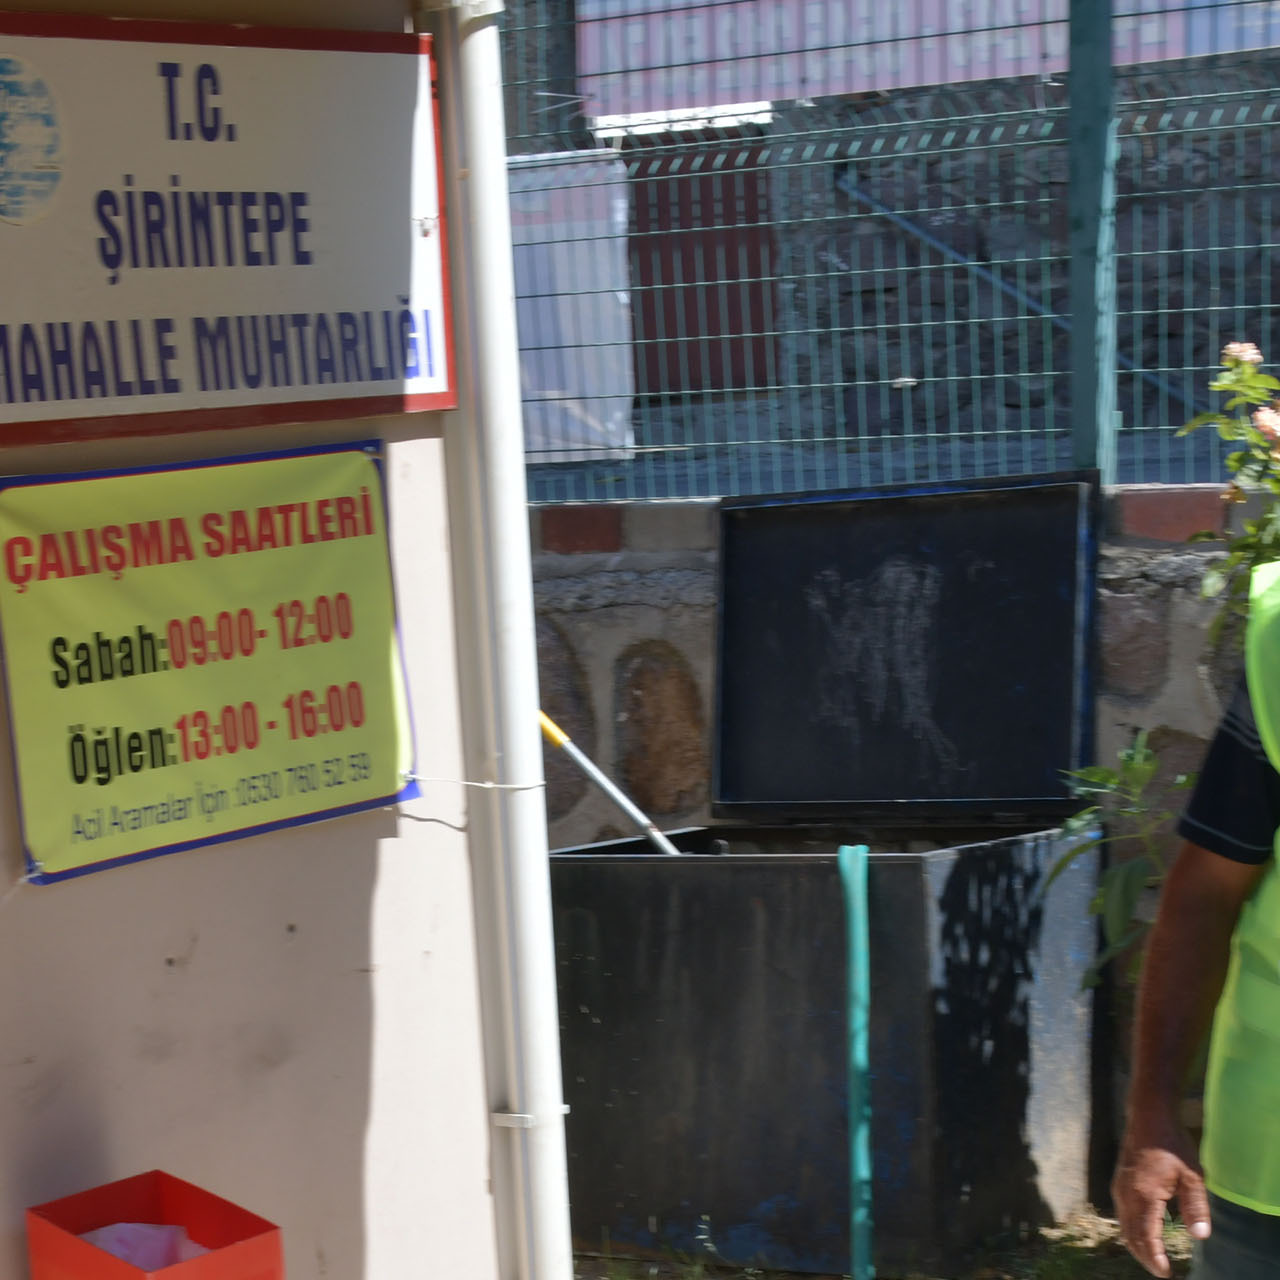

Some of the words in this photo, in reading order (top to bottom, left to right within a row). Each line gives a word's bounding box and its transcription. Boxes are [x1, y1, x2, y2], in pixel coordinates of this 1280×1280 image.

[157, 62, 238, 142] T.C.
[94, 174, 313, 285] ŞİRİNTEPE
[194, 295, 436, 393] MUHTARLIĞI
[4, 517, 196, 594] ÇALIŞMA
[201, 487, 376, 558] SAATLERİ
[273, 592, 353, 650] 12:00
[282, 681, 365, 740] 16:00
[72, 808, 104, 844] Acil
[109, 793, 192, 835] Aramalar
[322, 758, 345, 787] 52
